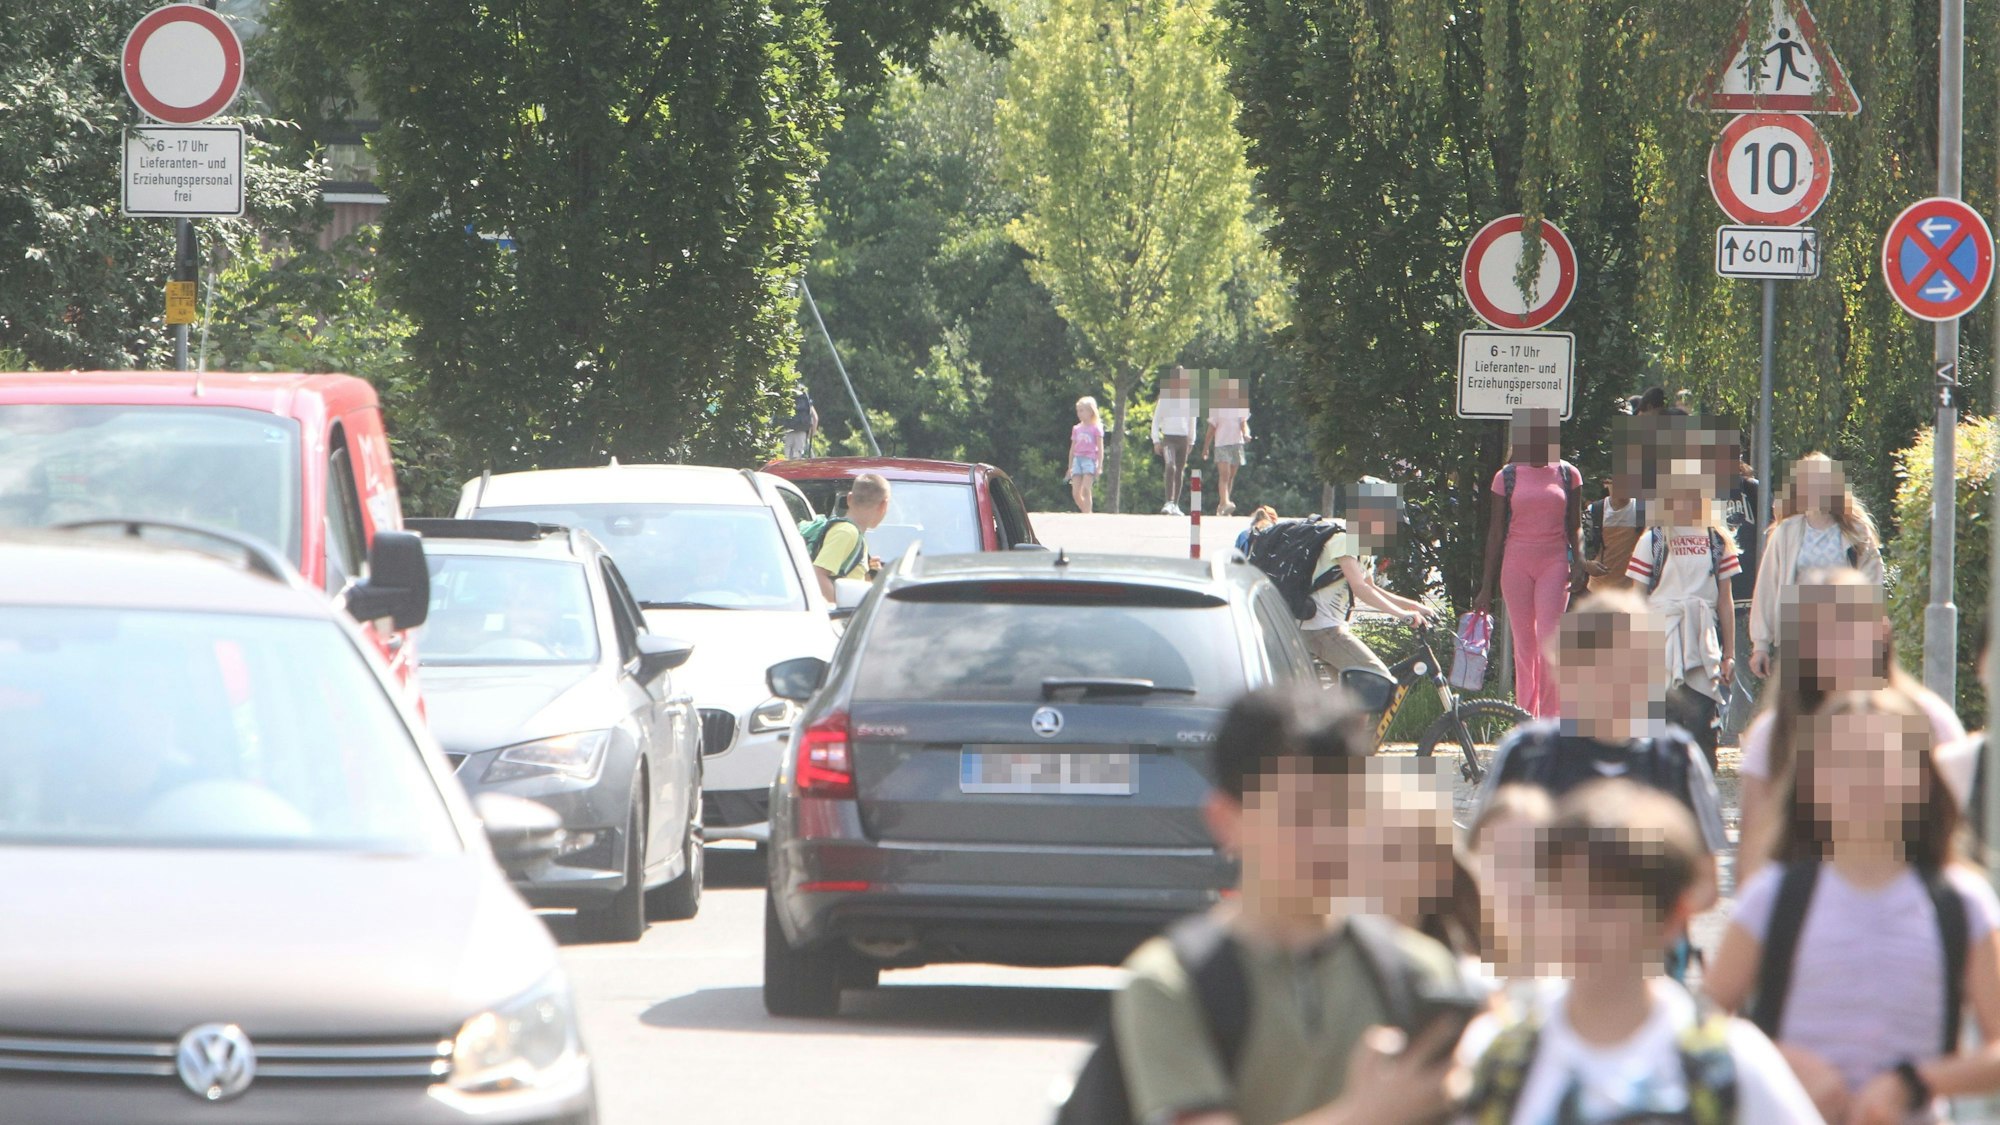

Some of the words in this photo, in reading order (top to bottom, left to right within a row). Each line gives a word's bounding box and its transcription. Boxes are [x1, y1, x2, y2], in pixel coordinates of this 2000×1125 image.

[156, 140, 165, 152] 6
[177, 140, 187, 152] 17
[191, 140, 208, 152] Uhr
[140, 157, 204, 169] Lieferanten-
[208, 157, 226, 169] und
[1744, 142, 1797, 195] 10
[133, 173, 232, 188] Erziehungspersonal
[174, 190, 192, 202] frei
[1490, 345, 1498, 357] 6
[1510, 346, 1520, 357] 17
[1523, 346, 1541, 358] Uhr
[1475, 361, 1535, 373] Lieferanten-
[1538, 363, 1556, 374] und
[1468, 376, 1562, 391] Erziehungspersonal
[1505, 393, 1522, 405] frei
[1669, 535, 1711, 548] TRANGER
[1177, 730, 1218, 743] OCTA
